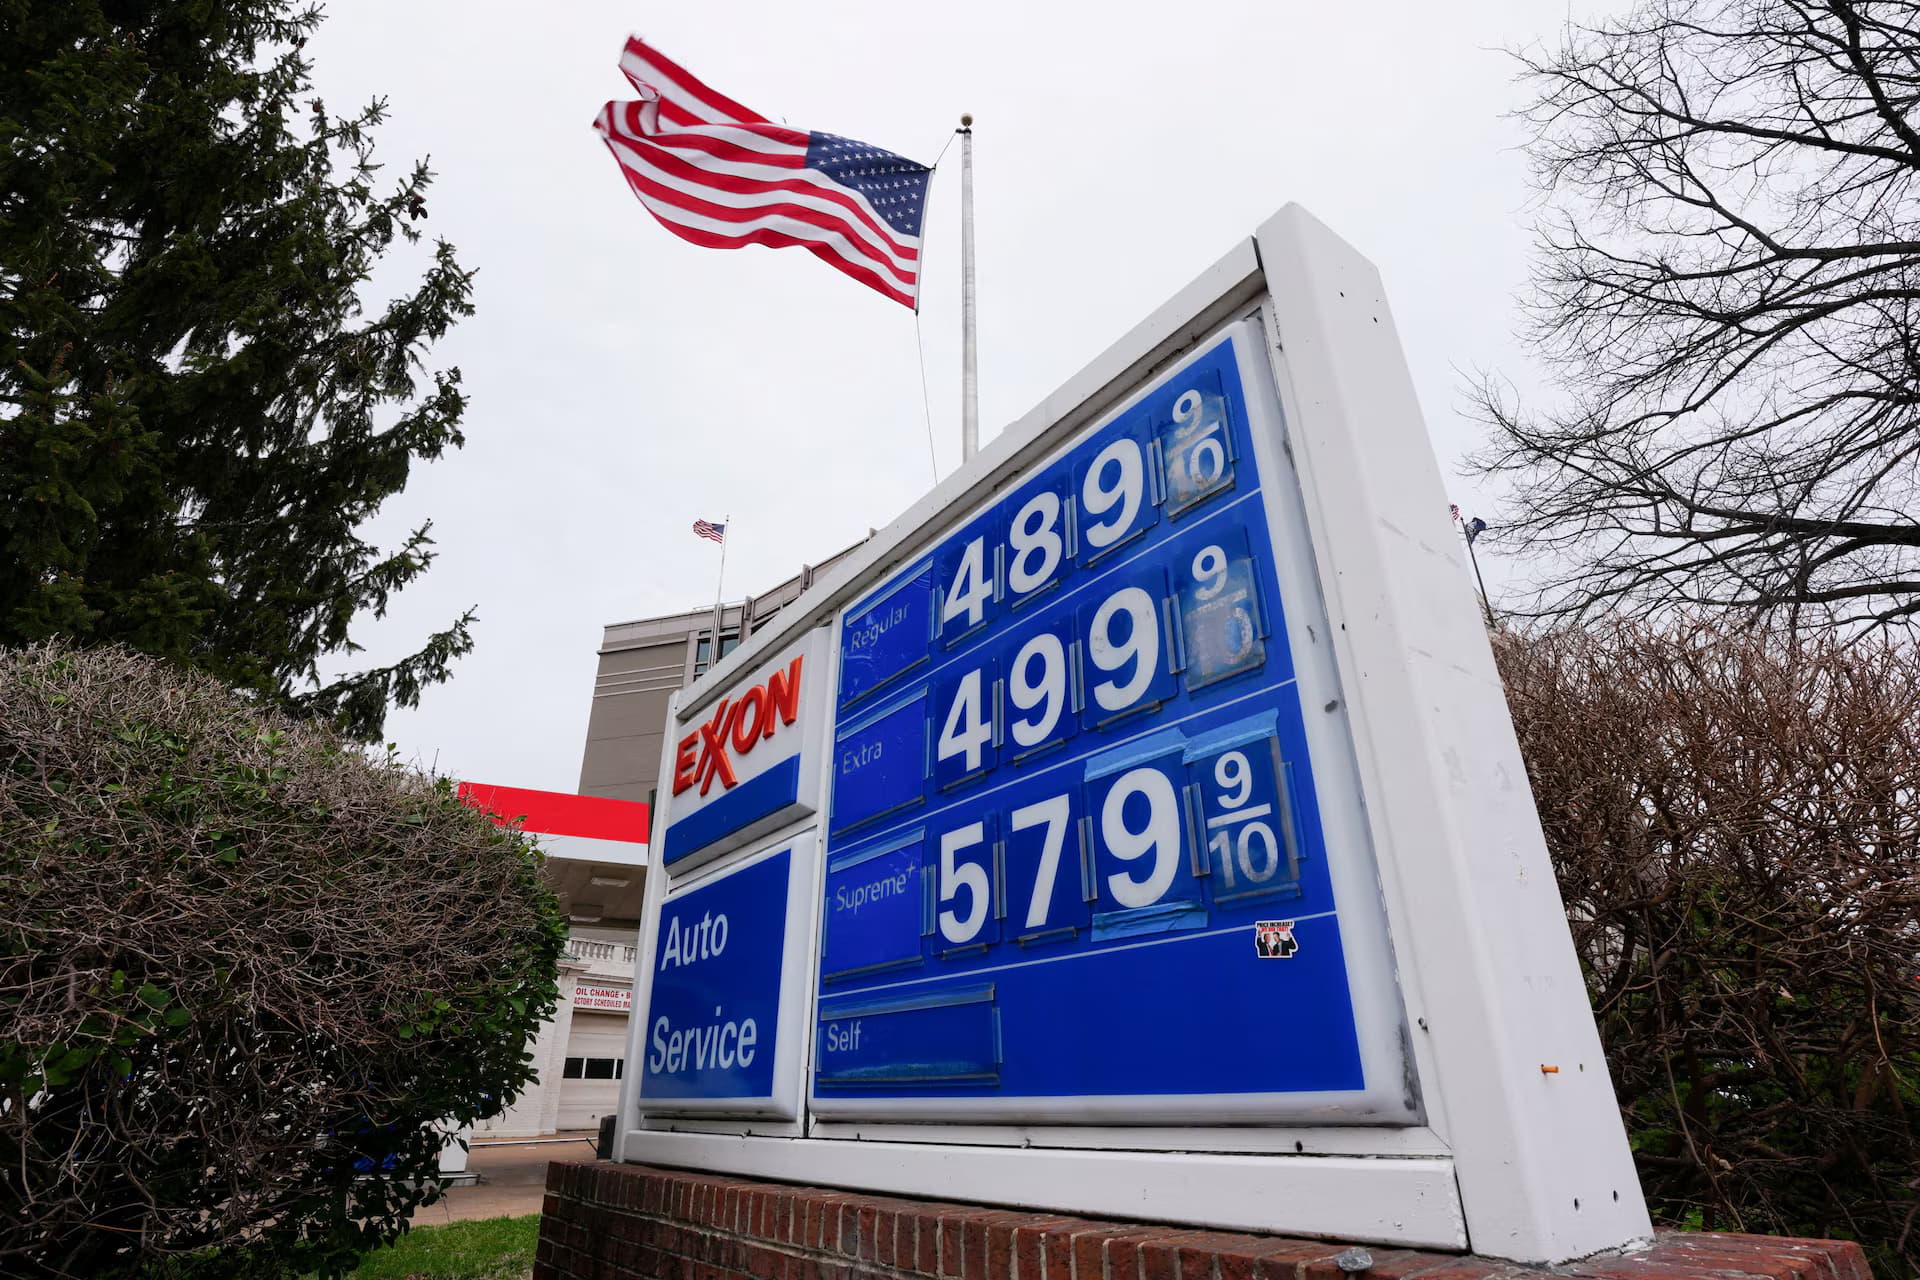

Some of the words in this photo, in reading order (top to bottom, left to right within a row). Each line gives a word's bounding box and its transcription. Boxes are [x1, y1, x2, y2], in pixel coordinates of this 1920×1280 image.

[1172, 389, 1202, 439] 9
[1192, 545, 1227, 600] 9
[850, 602, 911, 653] Regular
[672, 654, 803, 797] EXXON
[843, 741, 882, 774] Extra
[1214, 751, 1252, 809] 9
[1209, 821, 1278, 888] 10
[661, 910, 728, 971] Auto
[574, 997, 593, 1006] ACTORY
[594, 999, 622, 1008] SCHEDULED
[575, 987, 589, 996] OIL
[590, 988, 619, 998] CHANGE
[650, 1006, 757, 1075] Service
[827, 1021, 861, 1052] Self
